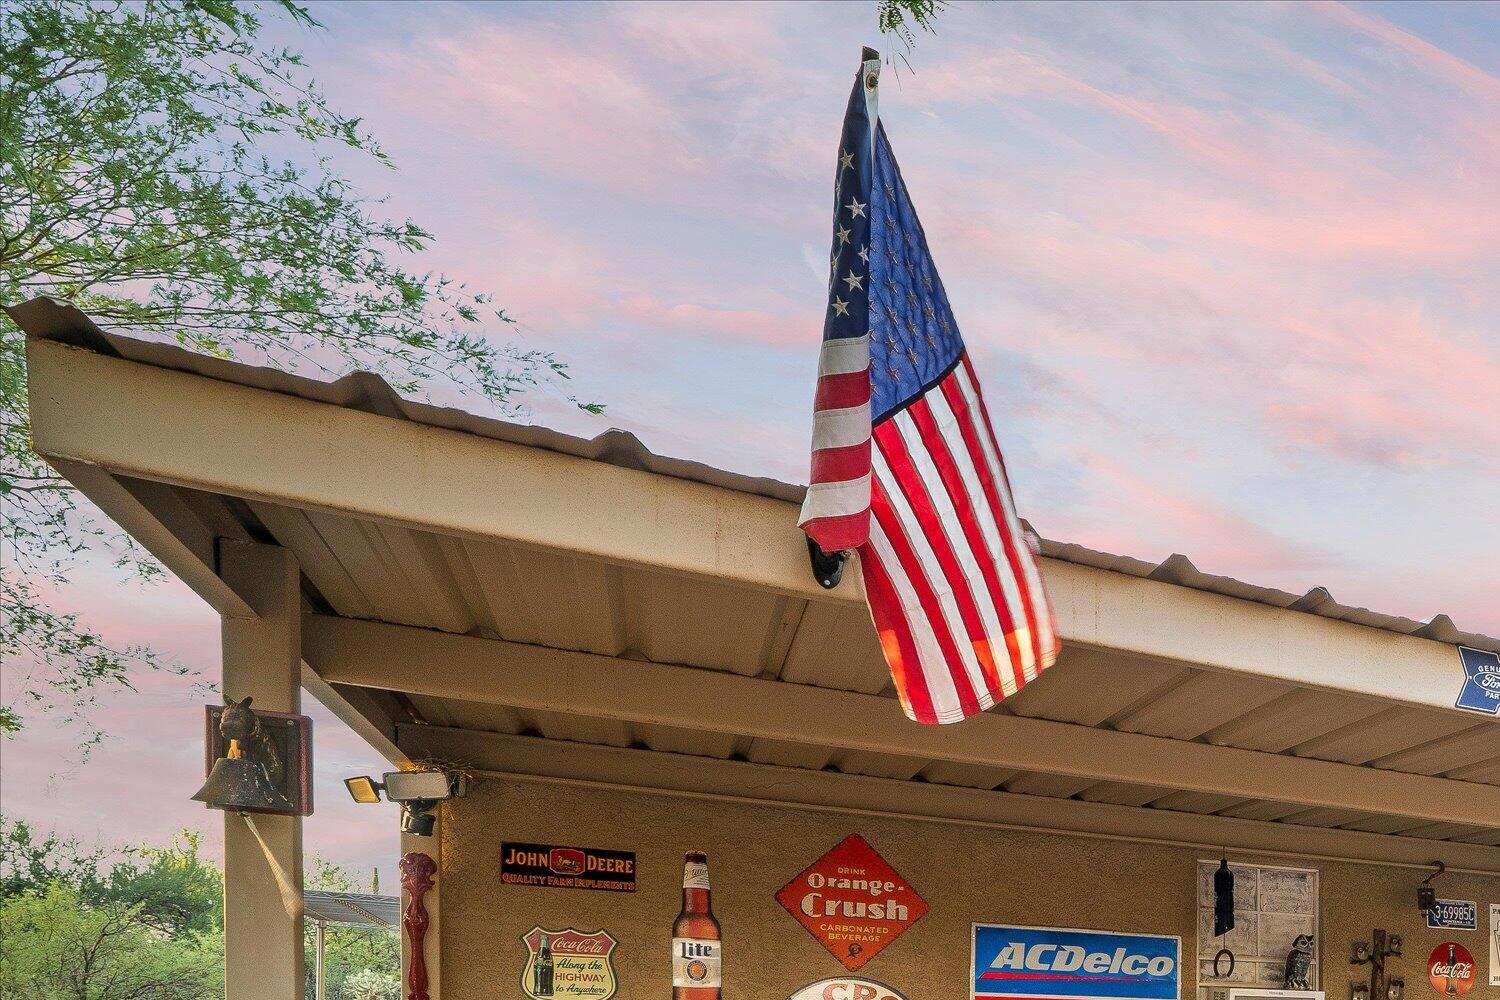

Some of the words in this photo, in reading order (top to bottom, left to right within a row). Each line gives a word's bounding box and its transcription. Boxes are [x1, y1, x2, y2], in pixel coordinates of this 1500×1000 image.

[505, 848, 548, 867] JOHN
[587, 855, 634, 874] DEERE
[837, 866, 866, 875] DRINK
[502, 872, 546, 885] QUALITY
[547, 875, 574, 888] FARM
[574, 877, 636, 891] IMPLEMENTS
[801, 892, 909, 922] Crush
[820, 923, 890, 935] CARBONATED
[828, 932, 881, 942] BEVERAGE
[551, 936, 604, 954] Coca-Cola
[681, 941, 713, 960] Lite
[556, 957, 587, 974] Along
[588, 957, 604, 971] the
[989, 942, 1175, 977] ACDelco
[555, 971, 606, 984] HIGHWAY
[1431, 961, 1473, 979] Coca-Cola
[555, 984, 565, 994] to
[566, 984, 607, 997] Anywhere
